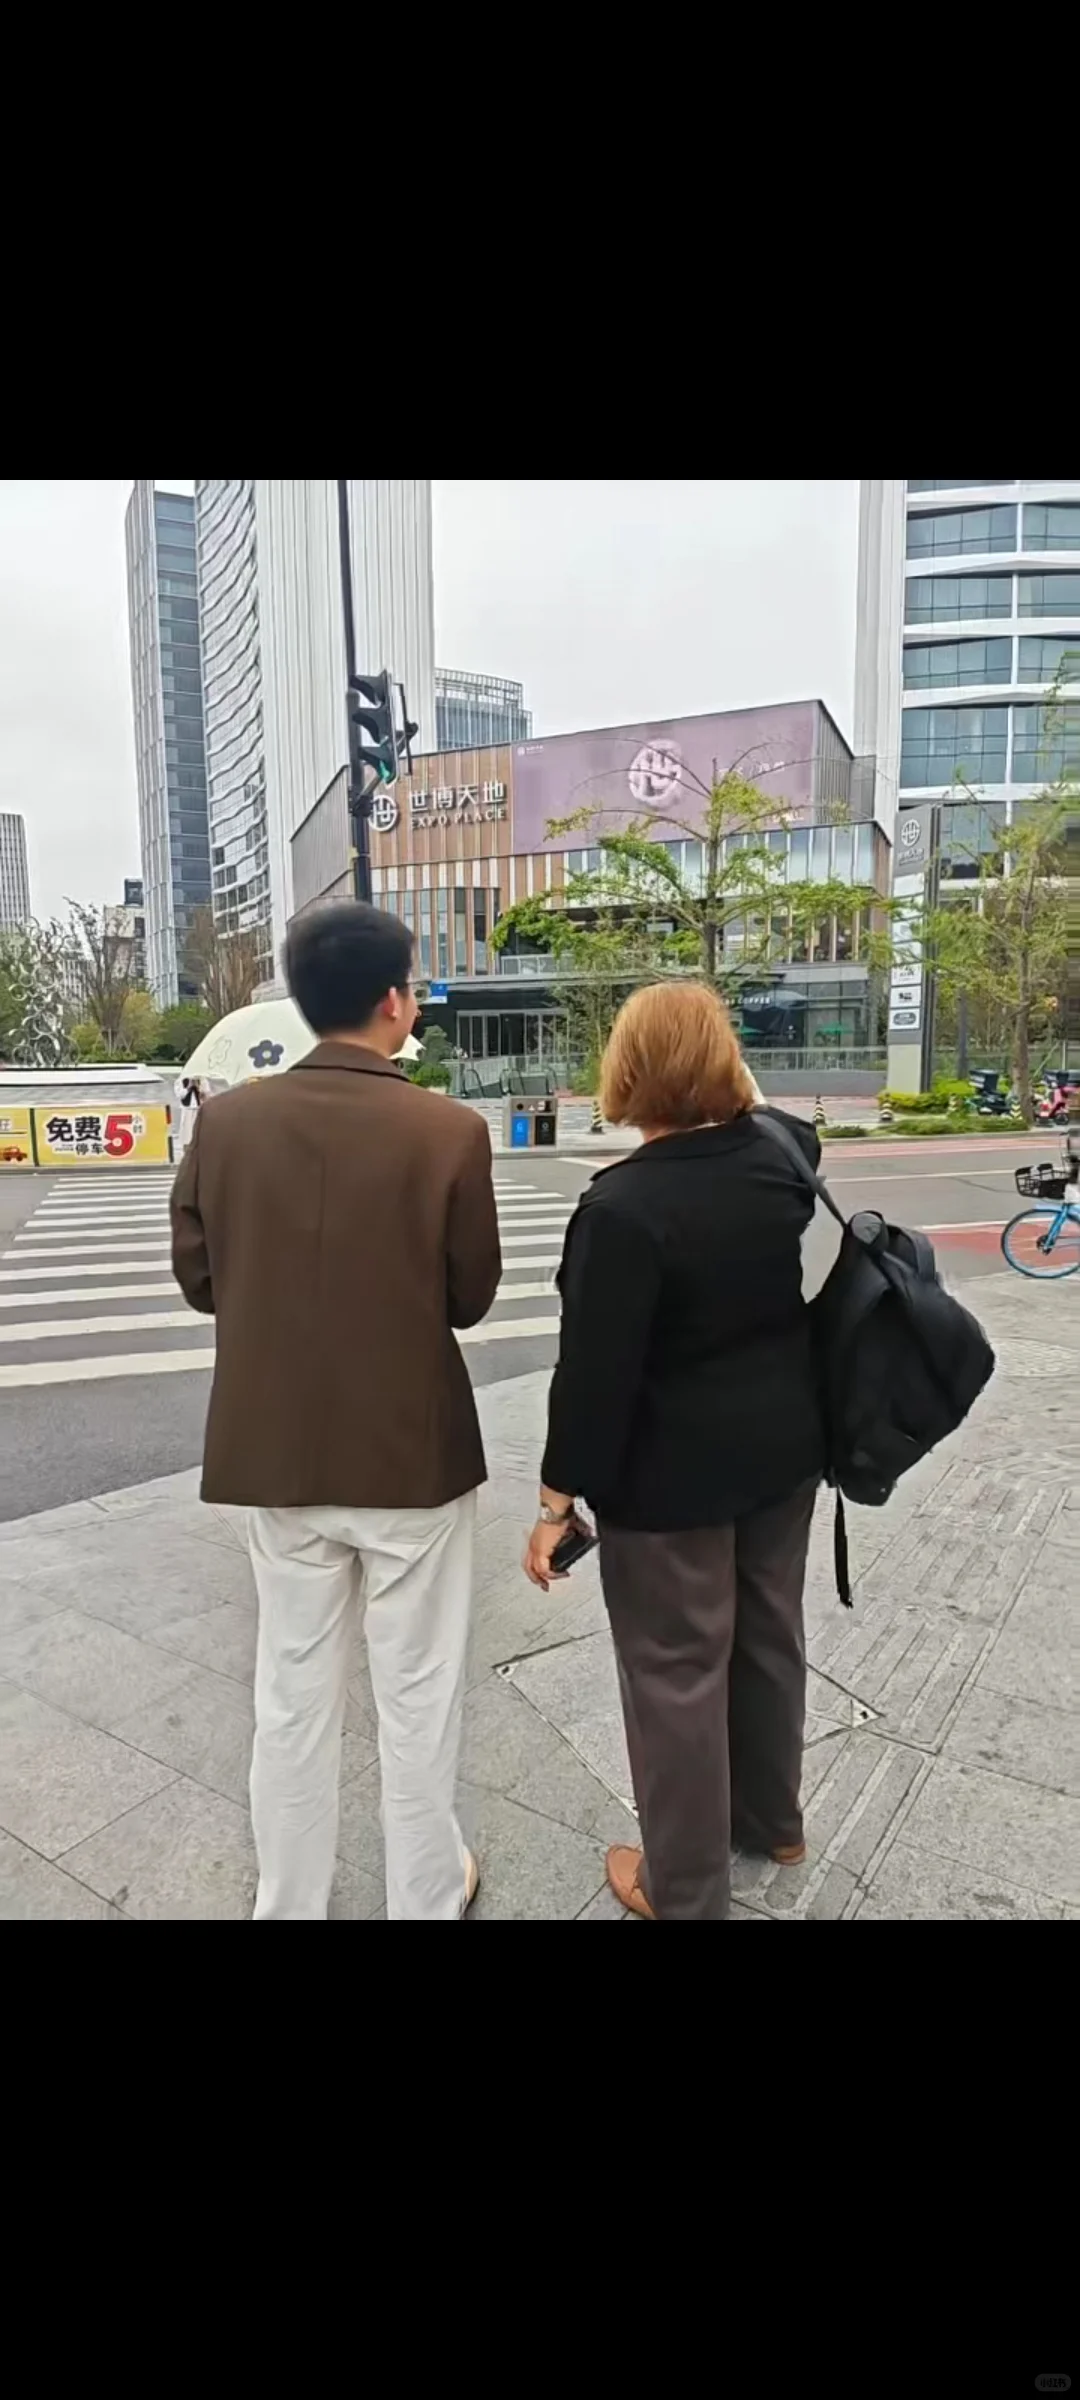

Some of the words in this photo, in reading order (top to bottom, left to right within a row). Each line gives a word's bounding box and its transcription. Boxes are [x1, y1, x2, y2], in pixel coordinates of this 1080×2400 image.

[410, 781, 505, 812] 世博天地
[412, 815, 447, 830] EXPO
[454, 809, 505, 825] PLACE
[46, 1116, 102, 1142] 免费
[104, 1114, 133, 1156] 5
[76, 1143, 103, 1155] 停车
